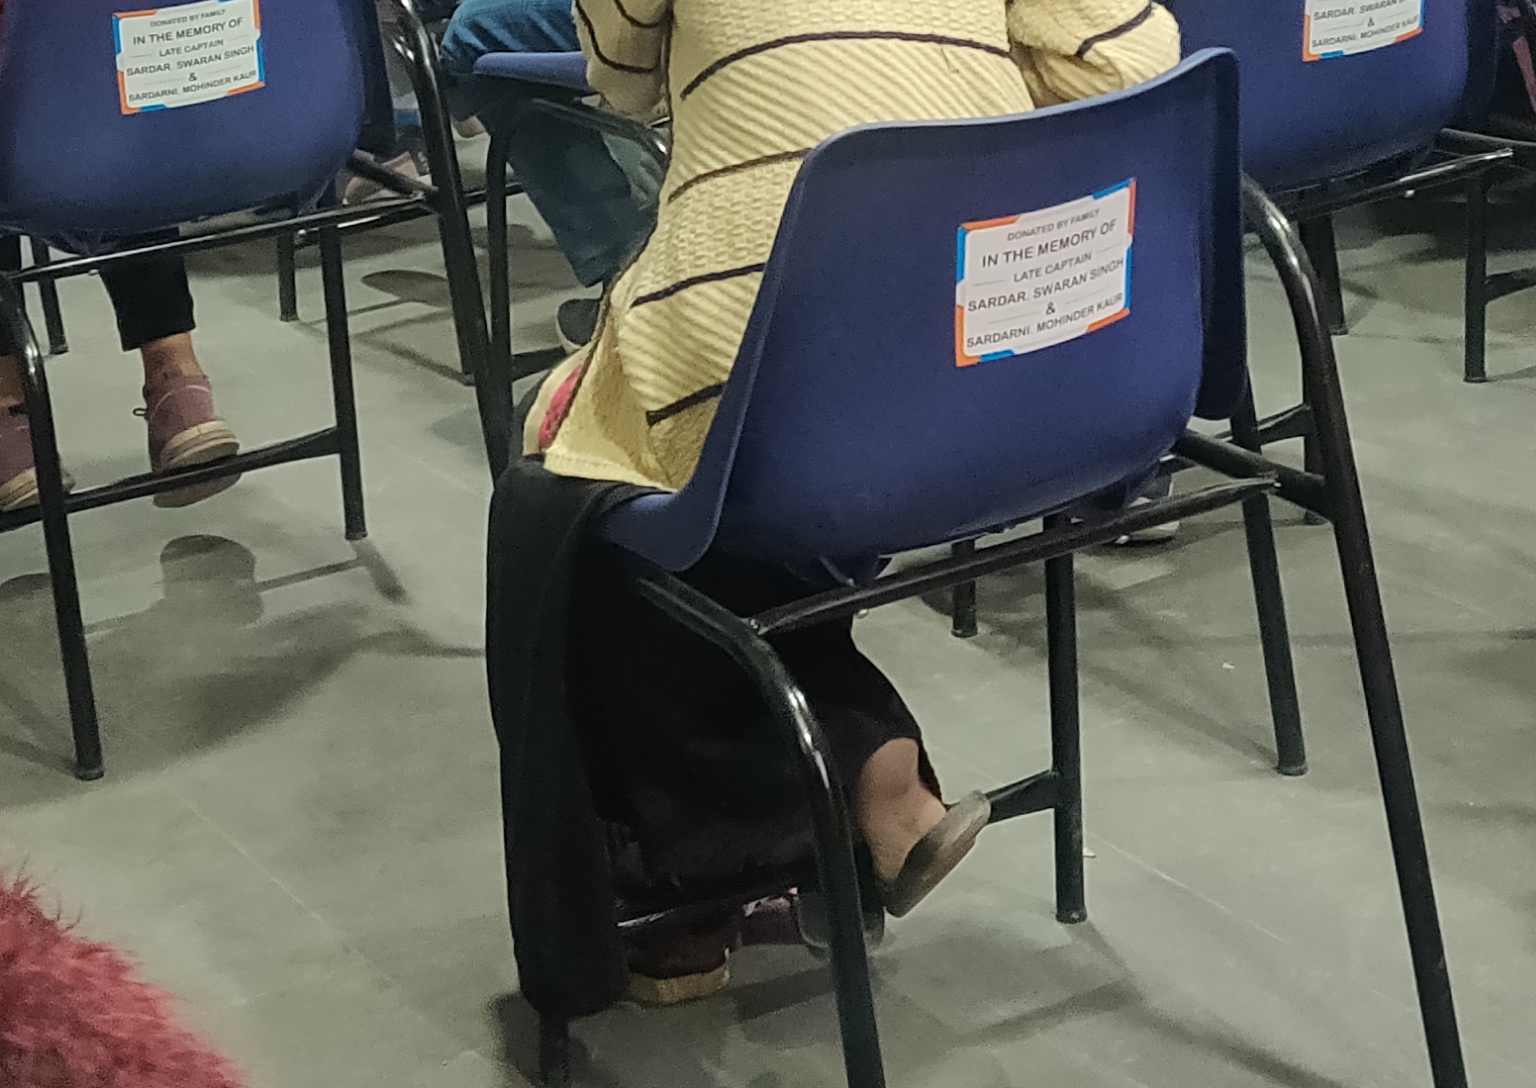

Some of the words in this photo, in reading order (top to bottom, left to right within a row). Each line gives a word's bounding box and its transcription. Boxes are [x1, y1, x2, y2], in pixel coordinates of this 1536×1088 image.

[150, 17, 187, 27] DONATED
[201, 9, 226, 19] FAMILY
[1368, 17, 1375, 26] &
[133, 36, 145, 45] IN
[150, 32, 173, 43] THE
[176, 22, 226, 38] MEMORY
[229, 17, 243, 28] OF
[159, 48, 182, 57] LATE
[184, 39, 224, 52] CAPTAIN
[177, 54, 222, 69] SWARAN
[224, 45, 254, 59] SINGH
[183, 78, 231, 93] MOHINDER
[233, 70, 256, 81] KAUR
[188, 72, 197, 81] &
[1007, 224, 1054, 241] DONATED
[1056, 220, 1069, 229] BY
[1070, 209, 1100, 225] FAMILY
[982, 255, 998, 268] IN
[1003, 247, 1034, 264] THE
[1037, 228, 1097, 256] MEMORY
[1100, 219, 1116, 235] OF
[1014, 267, 1043, 282] LATE
[1045, 252, 1092, 274] CAPTAIN
[1033, 274, 1088, 298] SWARAN
[1090, 257, 1124, 280] SINGH
[1037, 305, 1094, 331] MOHINDER
[1097, 293, 1123, 311] KAUR
[1046, 302, 1056, 315] &
